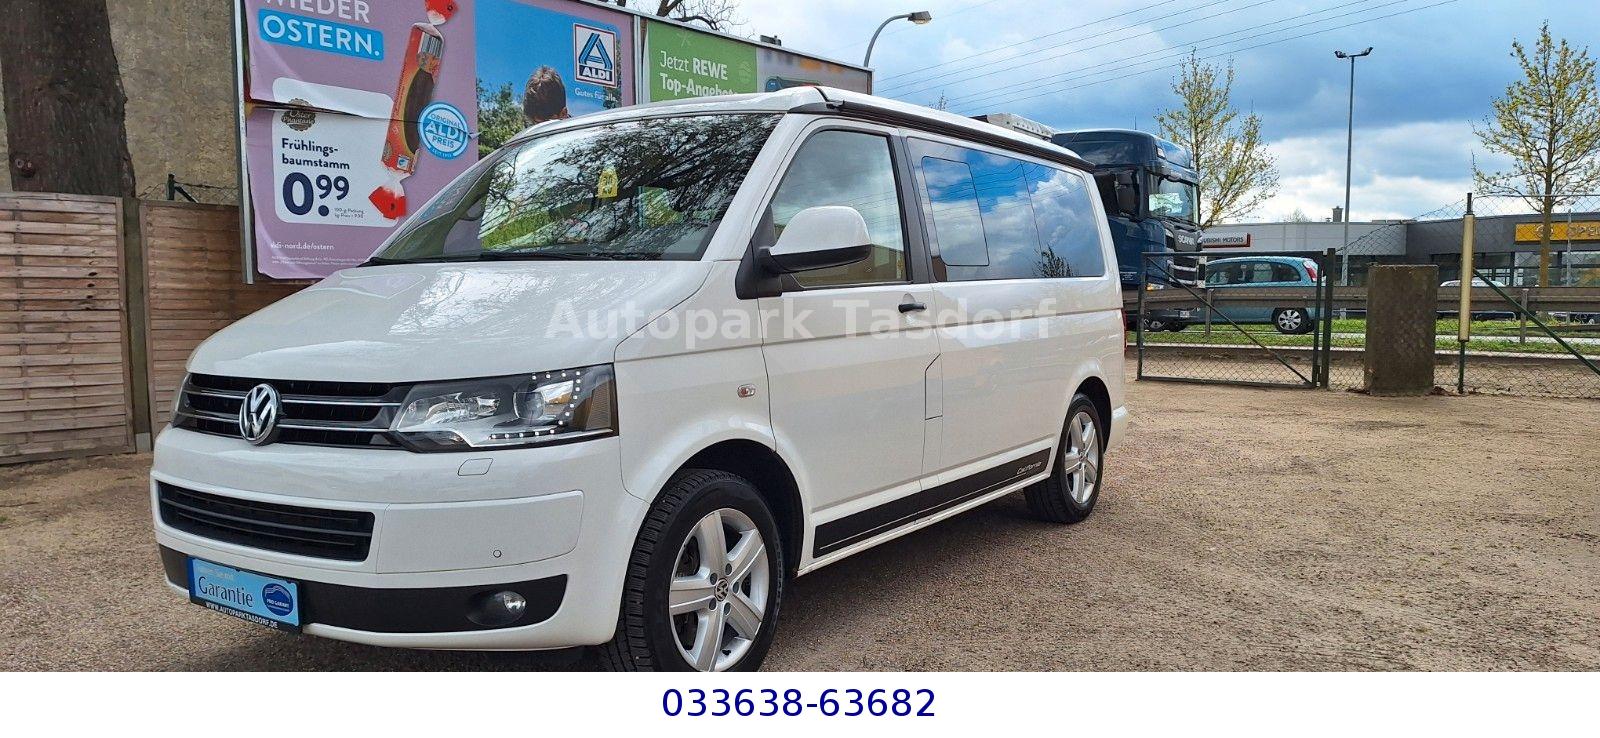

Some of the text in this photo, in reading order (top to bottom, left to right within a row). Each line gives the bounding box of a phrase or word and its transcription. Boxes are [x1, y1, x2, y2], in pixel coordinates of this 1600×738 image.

[264, 0, 370, 23] EDER
[262, 15, 380, 56] OSTERN.
[582, 66, 610, 80] ALDI
[660, 50, 728, 81] Jetzt REWE
[575, 87, 594, 98] Gutes
[660, 72, 739, 97] Top-Angebot
[424, 120, 464, 143] ALDI
[430, 113, 461, 129] ORIGINAL
[281, 137, 339, 157] Frühlings-
[432, 135, 455, 149] PREIS
[281, 153, 350, 171] baumstamm
[282, 171, 350, 217] 0.99
[198, 575, 253, 608] Garantie
[205, 601, 279, 629] WWW.AUTOPARKTASDORF.DE
